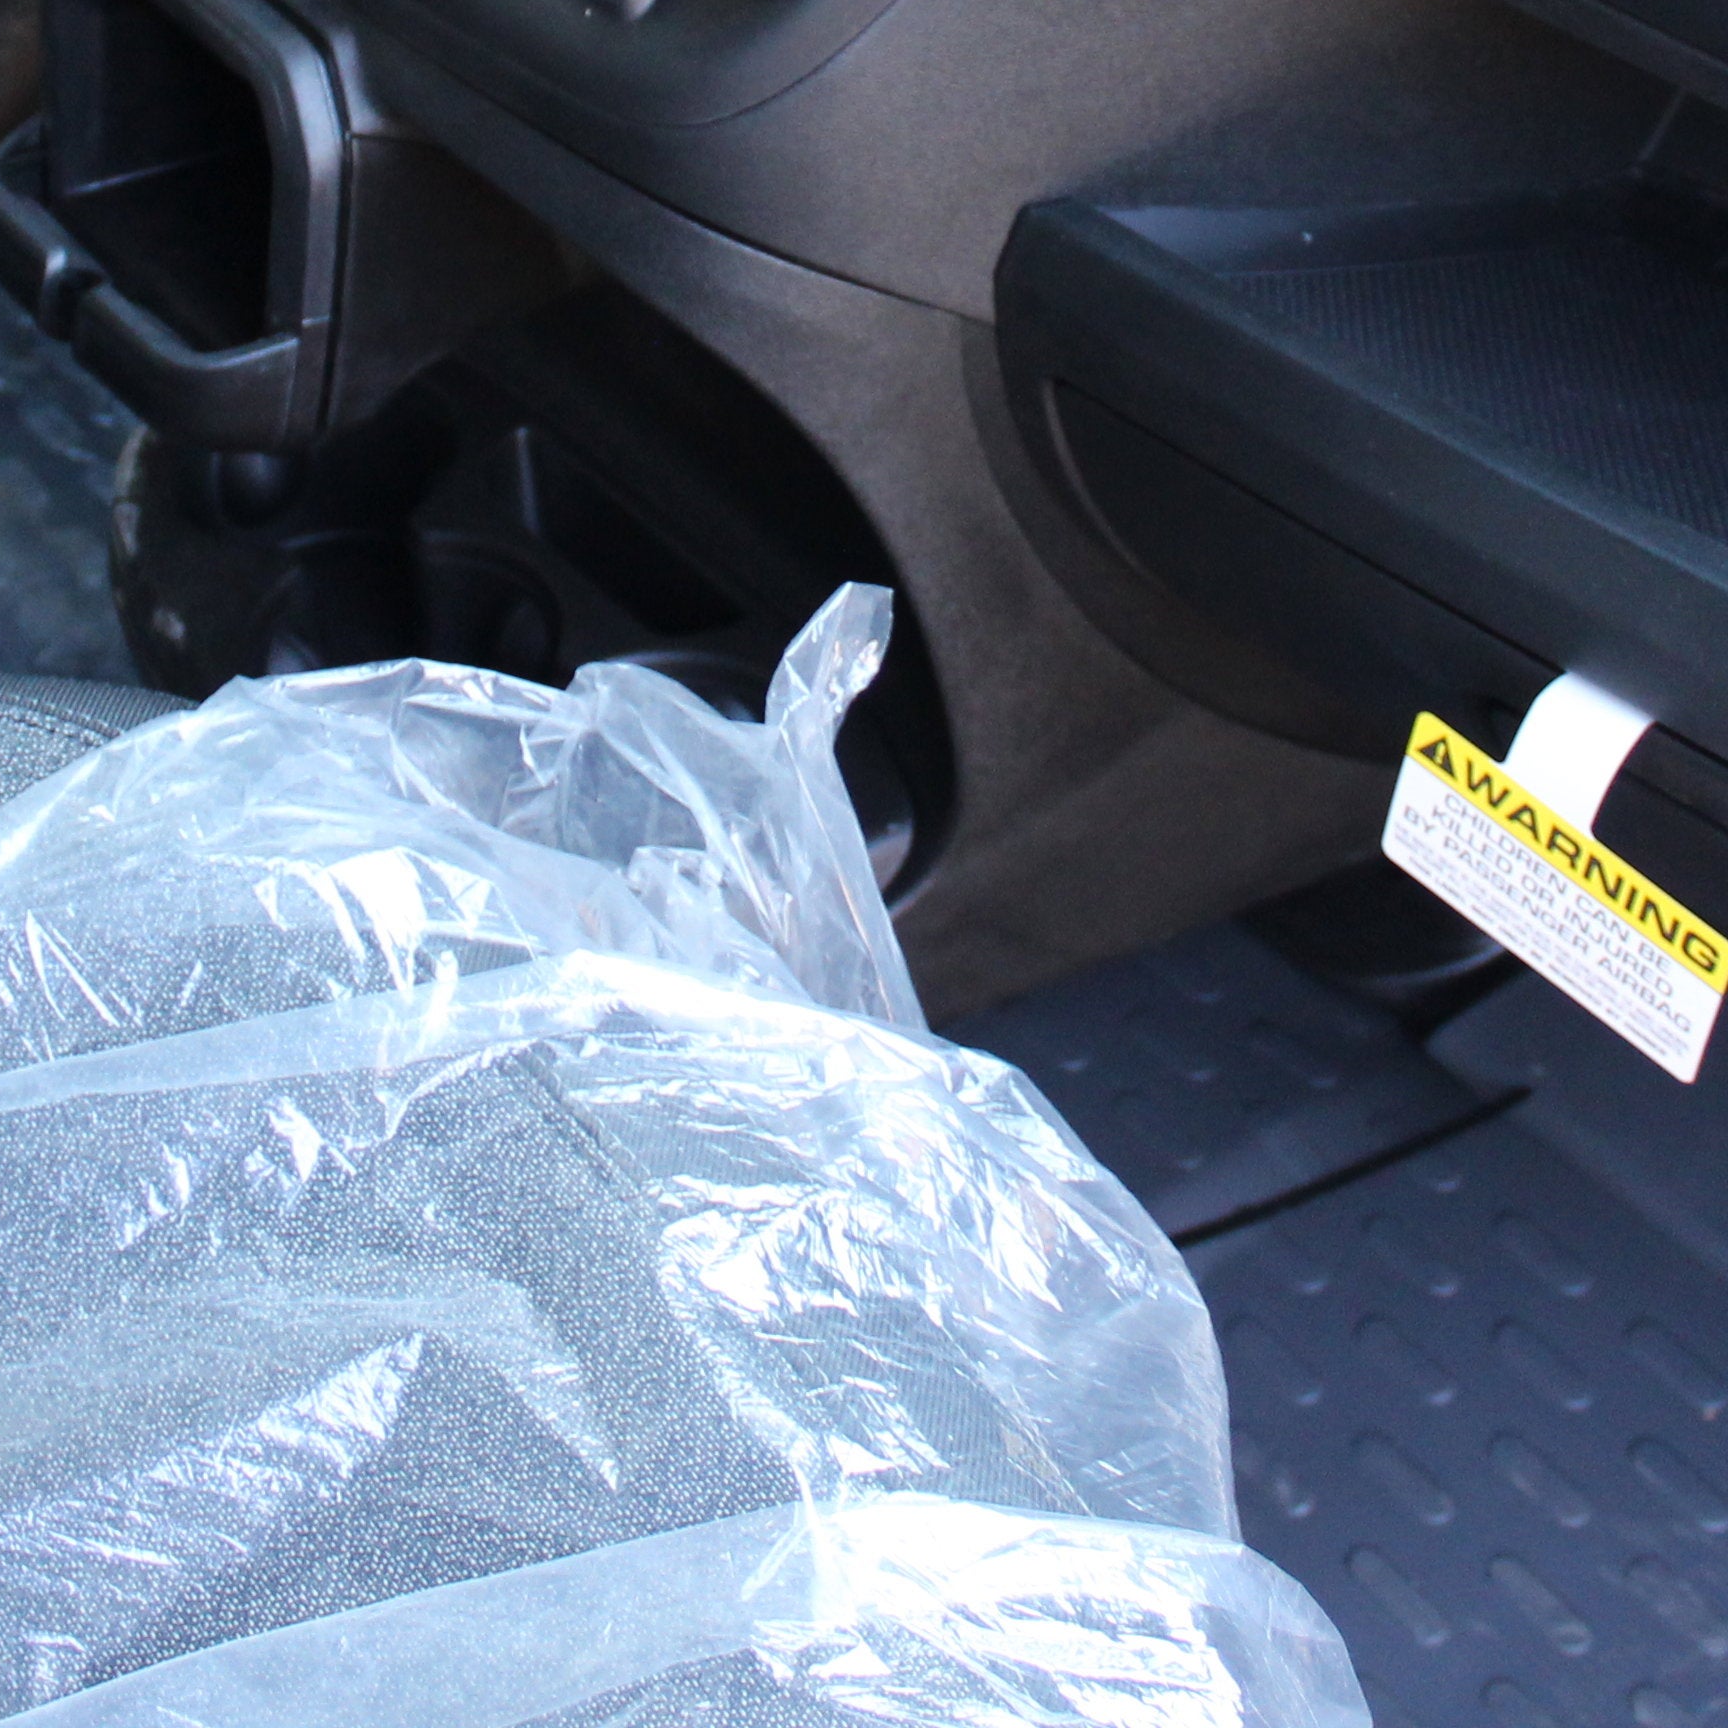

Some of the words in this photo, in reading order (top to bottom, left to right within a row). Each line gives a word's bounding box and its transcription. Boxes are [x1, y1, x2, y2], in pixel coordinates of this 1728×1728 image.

[1402, 804, 1436, 839] BY
[1442, 835, 1590, 956] PASSENGER
[1596, 953, 1693, 1035] AIRBAG
[1430, 805, 1513, 877] KILLED
[1520, 873, 1555, 908] OR
[1562, 906, 1673, 999] INJURED
[1442, 791, 1568, 896] CHILDREN
[1574, 892, 1630, 944] CAN
[1637, 940, 1671, 975] BE
[1465, 760, 1721, 974] WARNING
